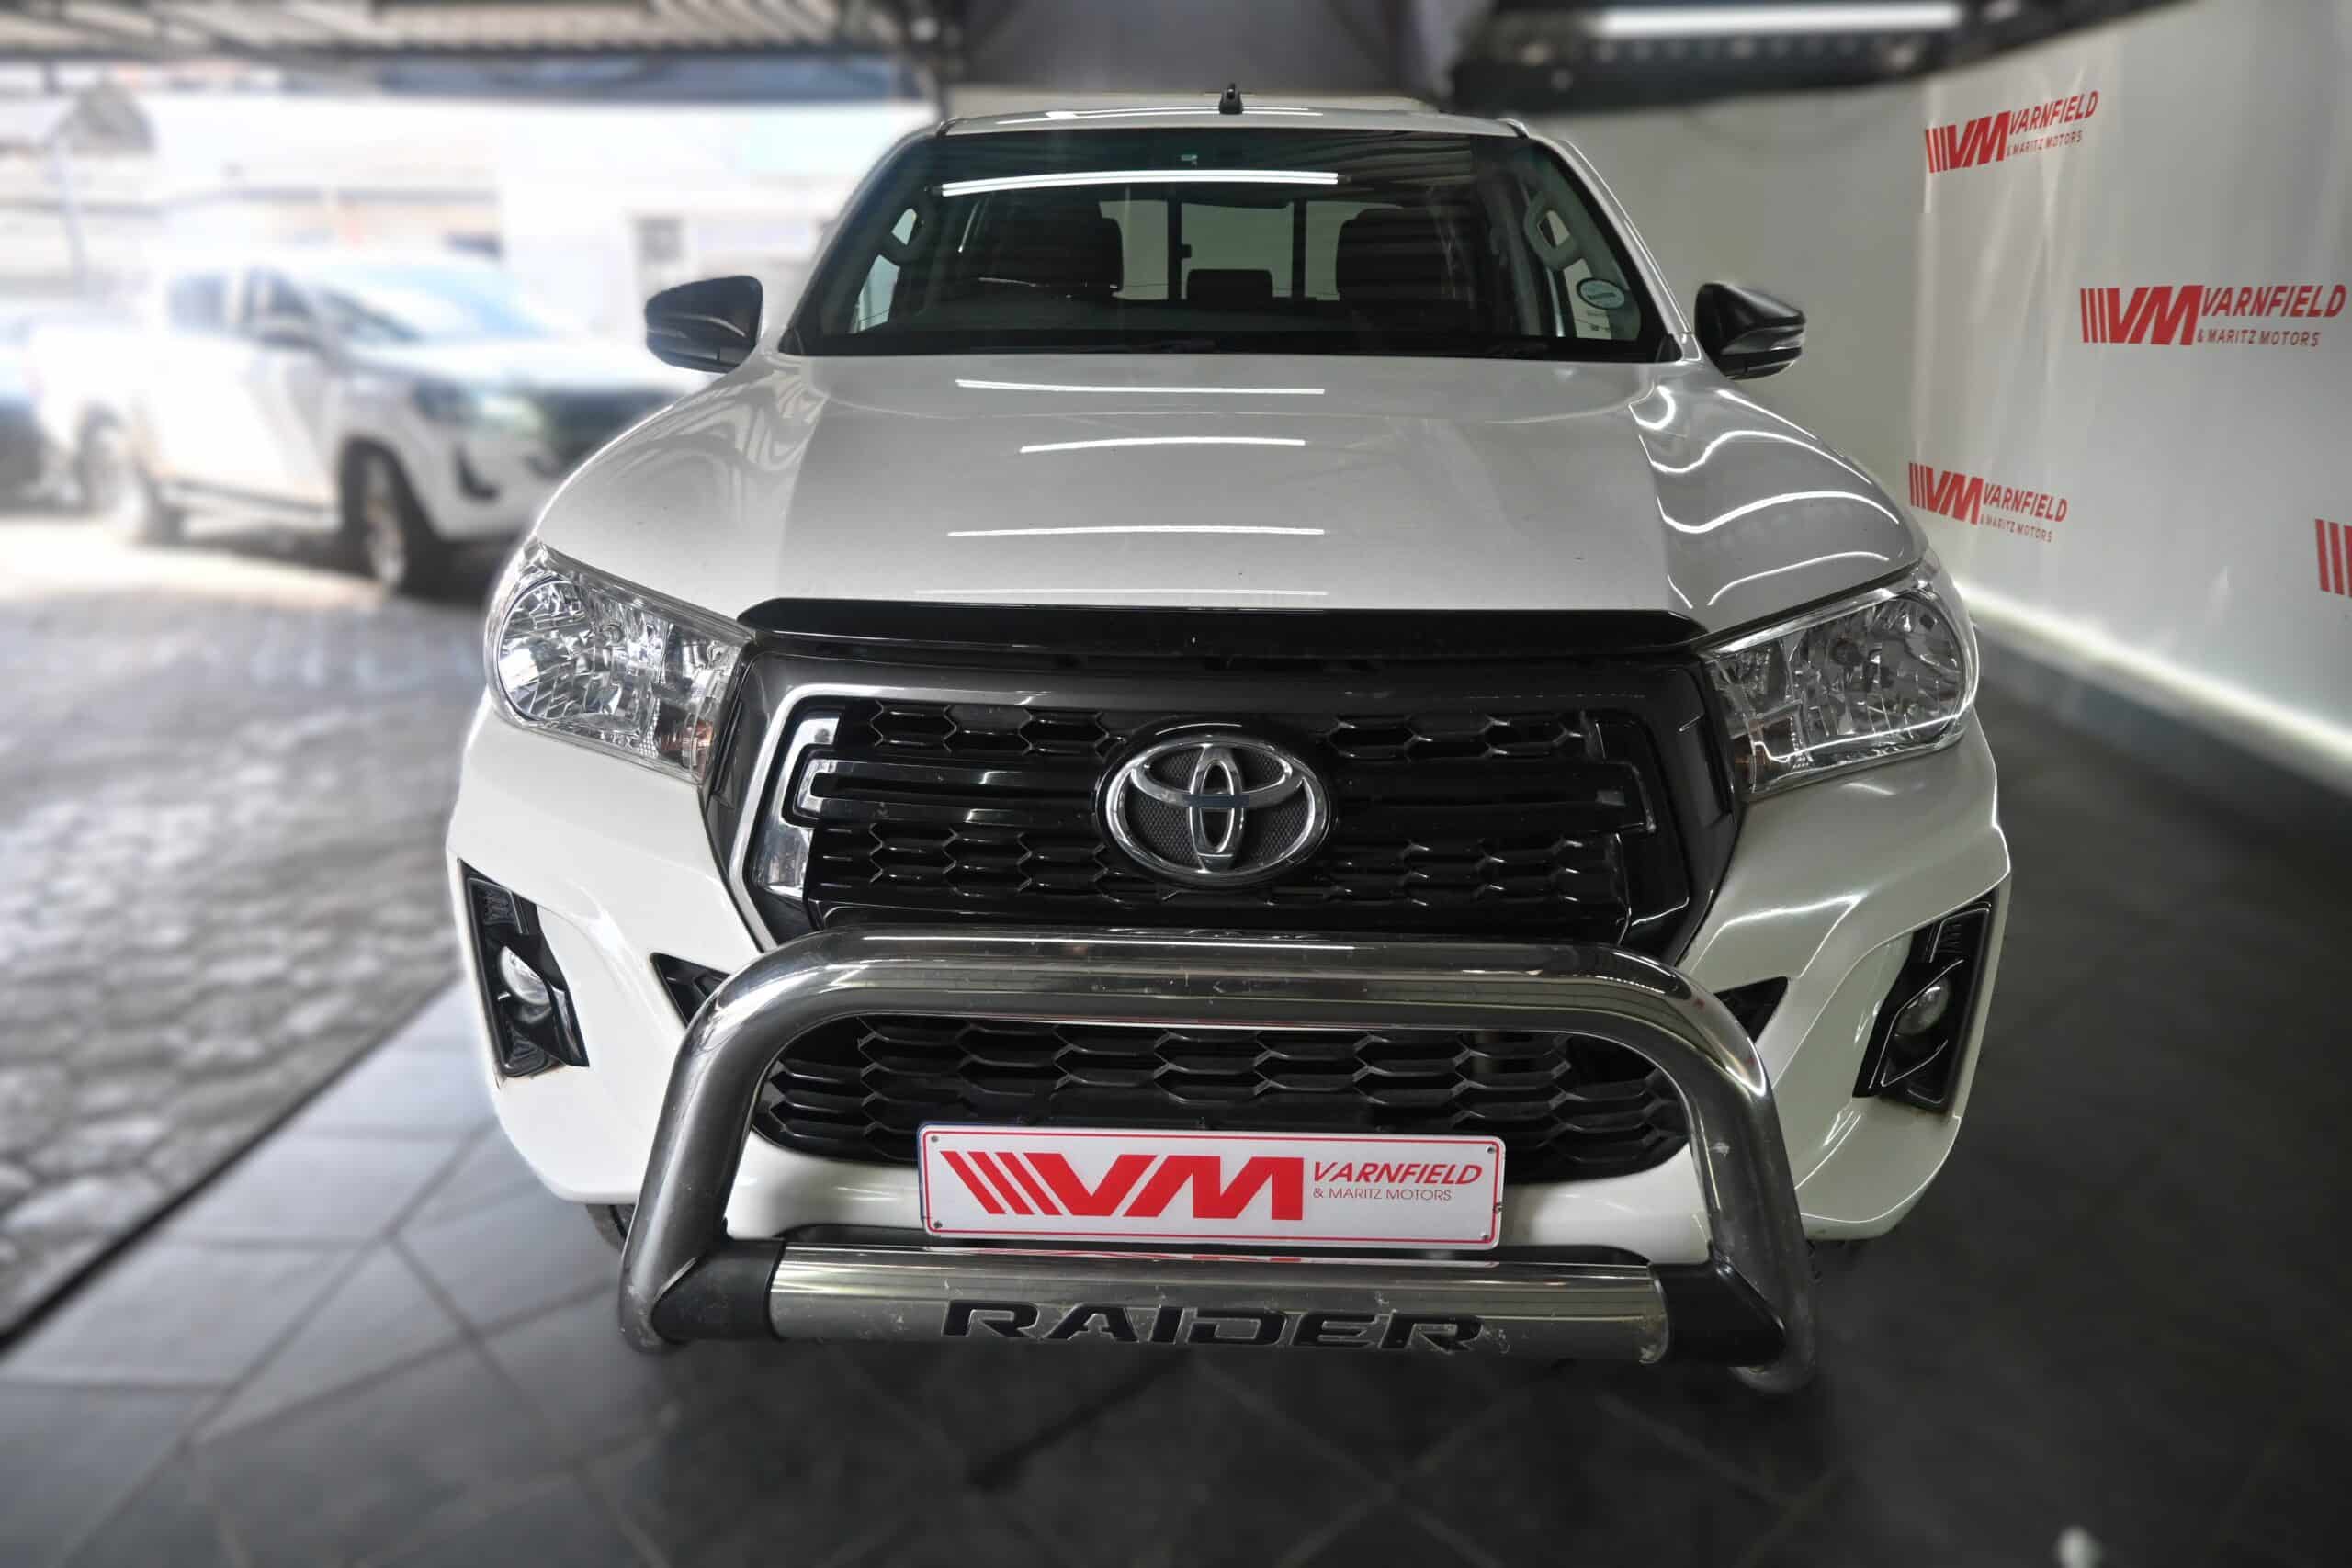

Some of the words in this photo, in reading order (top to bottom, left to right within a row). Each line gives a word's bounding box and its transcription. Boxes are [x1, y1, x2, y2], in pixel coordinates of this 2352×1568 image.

[2009, 90, 2100, 135] VARNFIELD
[2013, 138, 2043, 155] MARITZ
[2045, 130, 2083, 148] MOTORS
[2201, 284, 2347, 318] VARNFIELD
[2208, 329, 2256, 344] MARITZ
[2259, 330, 2320, 347] MOTORS
[1983, 482, 2069, 523] VARNFIELD
[1986, 515, 2016, 533] MARITZ
[2017, 521, 2053, 543] MOTORS
[1314, 1161, 1482, 1185] VARNFIELD
[1313, 1187, 1324, 1199] &
[1329, 1187, 1383, 1200] MARITZ
[1385, 1189, 1452, 1201] MOTORS
[942, 1299, 1483, 1353] RAIDER
